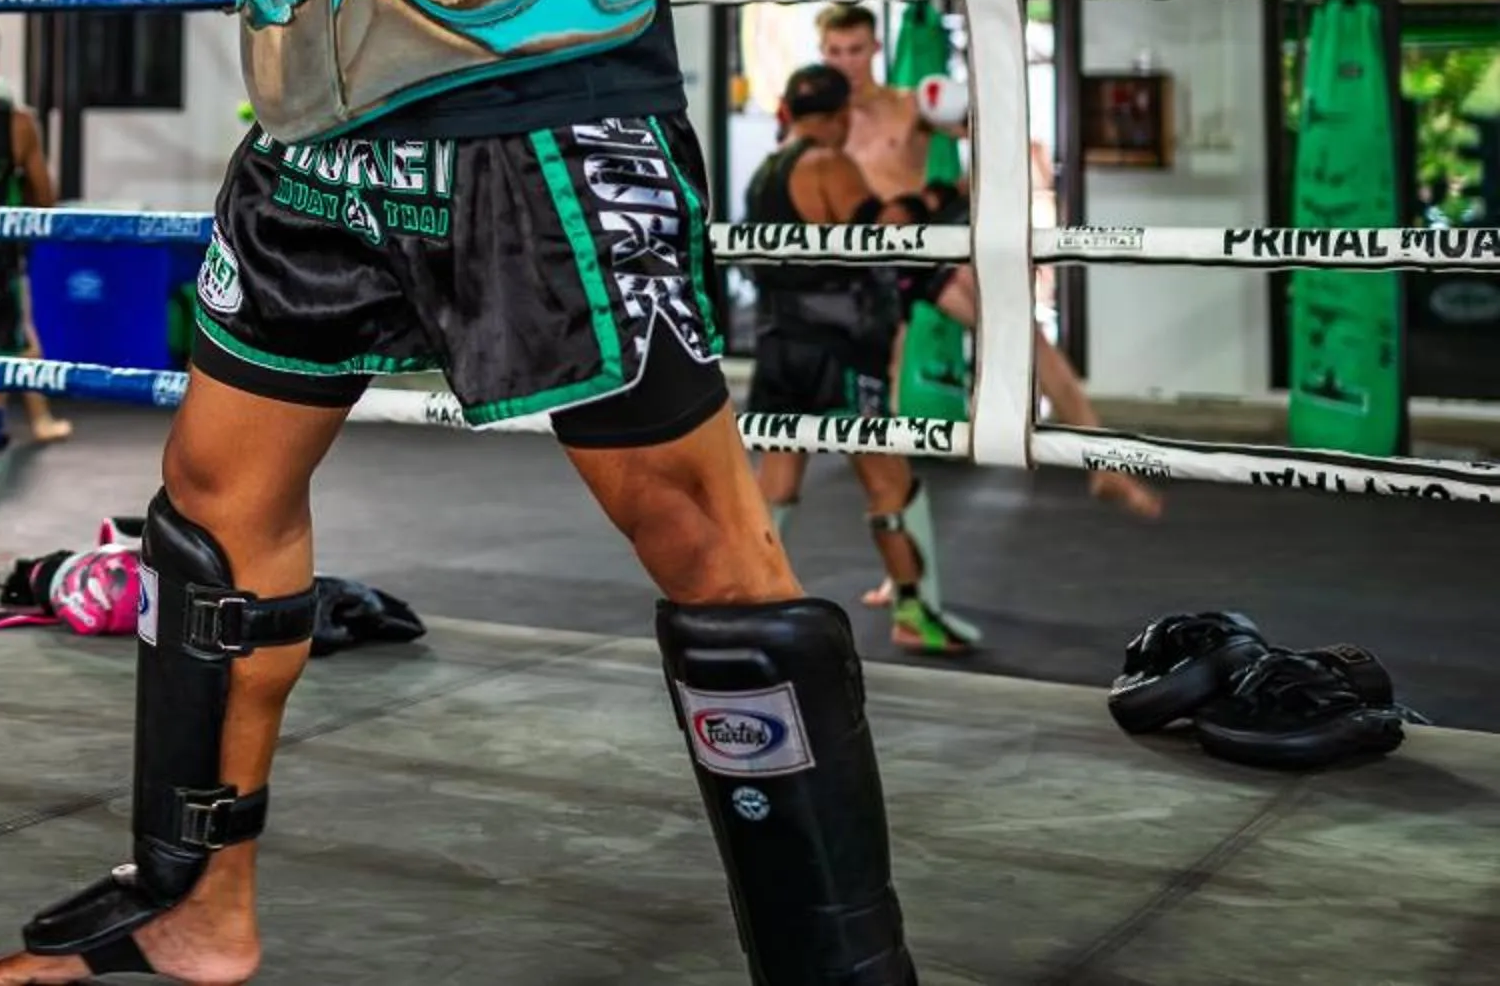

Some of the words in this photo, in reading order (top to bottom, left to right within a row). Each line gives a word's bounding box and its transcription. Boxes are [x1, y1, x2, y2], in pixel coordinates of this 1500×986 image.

[273, 175, 339, 220] MUAY
[383, 199, 450, 236] THAI
[1223, 229, 1389, 257] PRIMAL
[705, 718, 768, 747] Fairtex
